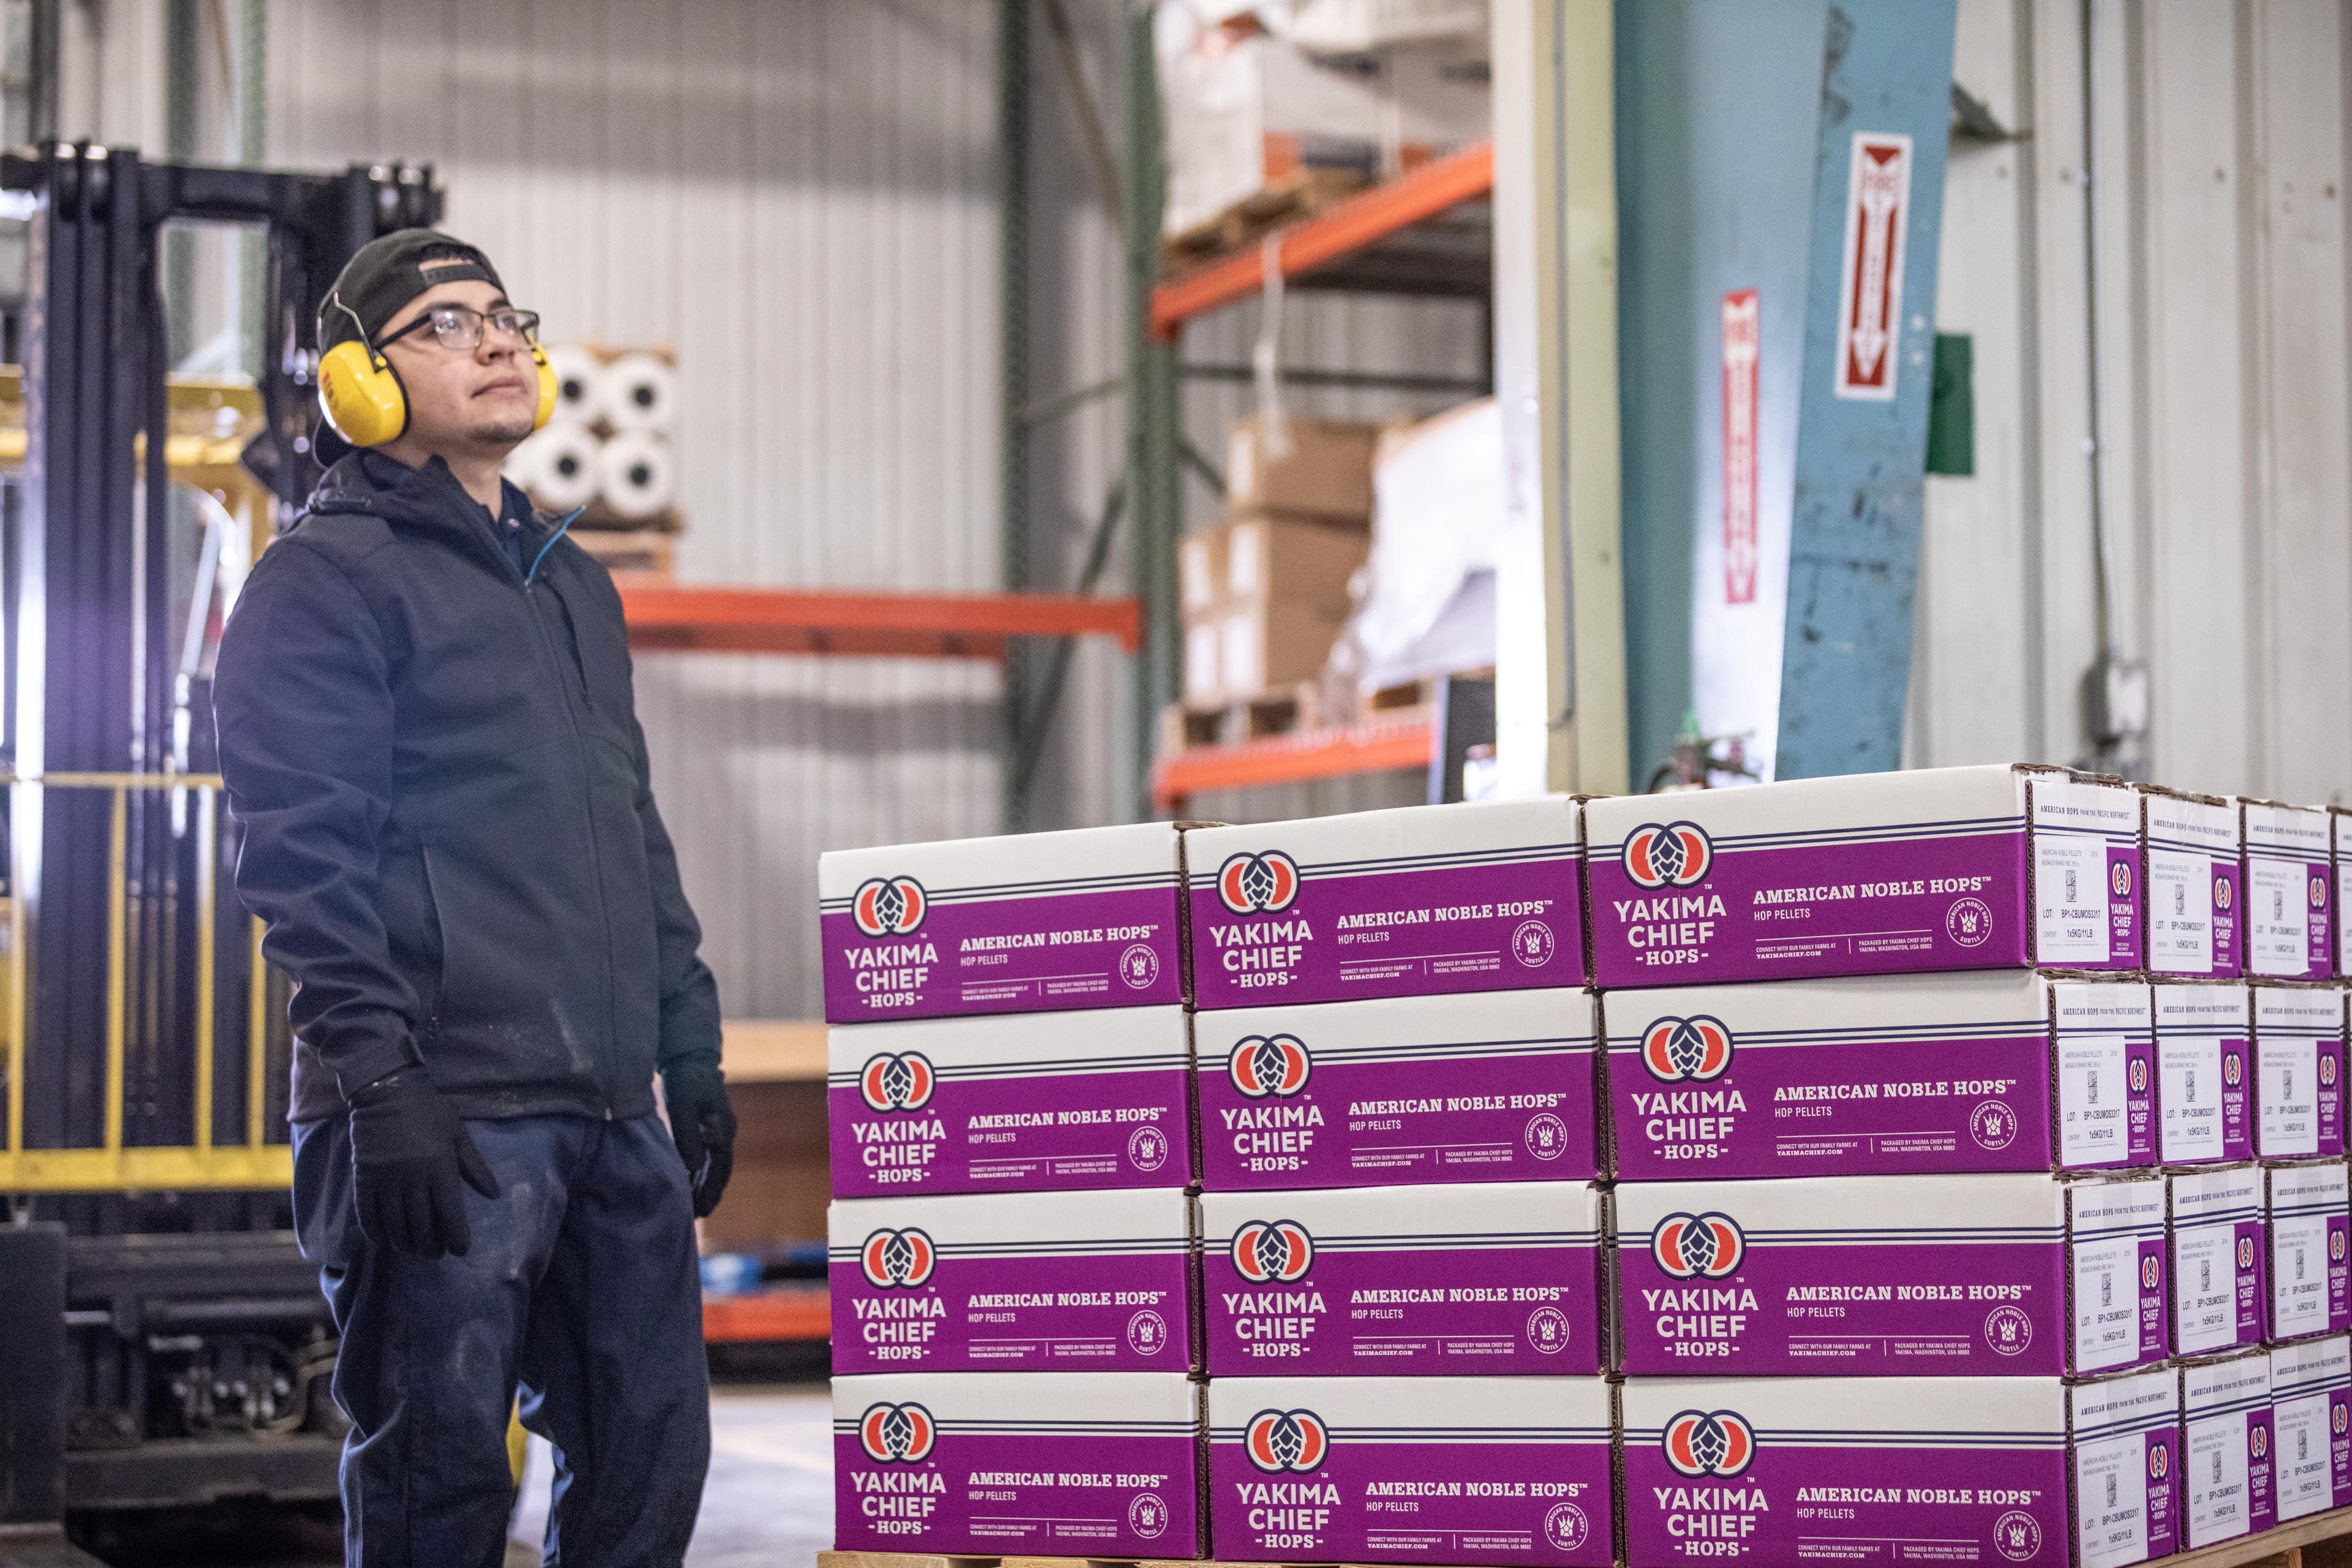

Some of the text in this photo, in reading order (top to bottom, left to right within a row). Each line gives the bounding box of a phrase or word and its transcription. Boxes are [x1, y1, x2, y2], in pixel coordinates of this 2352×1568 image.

[2041, 805, 2065, 813] AMERICAN
[1753, 885, 1855, 904] AMERICAN
[1861, 881, 1924, 898] NOBLE
[1613, 895, 1727, 922] YAKIMA
[1754, 908, 1810, 921] HOP PELLETS
[1950, 902, 1966, 927] AMERICAN
[1966, 901, 1983, 911] NOBLE
[2043, 909, 2053, 918] LOT:
[2111, 903, 2133, 915] YAKIMA
[1337, 909, 1430, 929] AMERICAN
[1434, 905, 1493, 921] NOBLE
[2114, 916, 2131, 927] CHIEF
[960, 933, 1046, 951] AMERICAN
[1050, 929, 1103, 944] NOBLE
[1209, 920, 1313, 947] YAKIMA
[1338, 932, 1389, 944] HOP PELLETS
[1628, 921, 1714, 948] CHIEF
[843, 943, 938, 968] YAKIMA
[961, 954, 1008, 967] HOP PELLETS
[1223, 945, 1302, 971] CHIEF
[1757, 951, 1821, 959] YAKIMACHIEF.COM
[856, 967, 928, 992] CHIEF
[1774, 1084, 1878, 1101] AMERICAN
[1883, 1082, 1948, 1098] NOBLE
[1349, 1099, 1442, 1115] AMERICAN
[1447, 1096, 1506, 1111] NOBLE
[1631, 1090, 1747, 1115] YAKIMA
[2128, 1100, 2149, 1111] YAKIMA
[968, 1112, 1054, 1129] AMERICAN
[1058, 1110, 1112, 1125] NOBLE
[1220, 1106, 1325, 1129] YAKIMA
[1775, 1106, 1832, 1117] HOP PELLETS
[2067, 1112, 2076, 1121] LOT:
[2132, 1112, 2147, 1123] CHIEF
[851, 1120, 946, 1143] YAKIMA
[1350, 1120, 1401, 1131] HOP PELLETS
[1646, 1117, 1734, 1141] CHIEF
[969, 1133, 1016, 1144] HOP PELLETS
[1234, 1131, 1313, 1154] CHIEF
[863, 1144, 936, 1166] CHIEF
[2079, 1209, 2101, 1218] AMERICAN
[968, 1294, 1054, 1308] AMERICAN
[1058, 1292, 1111, 1306] NOBLE
[1351, 1289, 1444, 1303] AMERICAN
[1449, 1288, 1507, 1302] NOBLE
[1642, 1289, 1759, 1311] YAKIMA
[1786, 1286, 1891, 1300] AMERICAN
[1897, 1286, 1963, 1300] NOBLE
[852, 1297, 946, 1319] YAKIMA
[1222, 1292, 1327, 1314] YAKIMA
[2141, 1296, 2160, 1309] YAKIMA
[969, 1313, 1016, 1323] HOP PELLETS
[1352, 1309, 1403, 1319] HOP PELLETS
[1787, 1307, 1845, 1317] HOP PELLETS
[2143, 1310, 2158, 1322] CHIEF
[1235, 1317, 1315, 1339] CHIEF
[1657, 1315, 1746, 1338] CHIEF
[2082, 1316, 2091, 1326] LOT:
[864, 1322, 936, 1343] CHIEF
[2081, 1404, 2105, 1415] AMERICAN
[2107, 1401, 2118, 1410] HOPS
[2250, 1463, 2269, 1477] YAKIMA
[851, 1472, 946, 1493] YAKIMA
[968, 1472, 1055, 1486] AMERICAN
[1058, 1473, 1112, 1487] NOBLE
[2252, 1476, 2267, 1488] CHIEF
[969, 1491, 1016, 1501] HOP PELLETS
[1235, 1483, 1341, 1505] YAKIMA
[1366, 1482, 1461, 1496] AMERICAN
[1466, 1482, 1526, 1496] NOBLE
[1796, 1488, 1901, 1502] AMERICAN
[1907, 1489, 1972, 1504] NOBLE
[2148, 1483, 2169, 1499] YAKIMA
[862, 1496, 936, 1517] CHIEF
[1366, 1502, 1419, 1512] HOP PELLETS
[1653, 1487, 1769, 1511] YAKIMA
[2151, 1497, 2168, 1512] CHIEF
[1249, 1509, 1329, 1530] CHIEF
[1797, 1508, 1855, 1519] HOP PELLETS
[1667, 1514, 1756, 1537] CHIEF
[2085, 1519, 2095, 1529] LOT:
